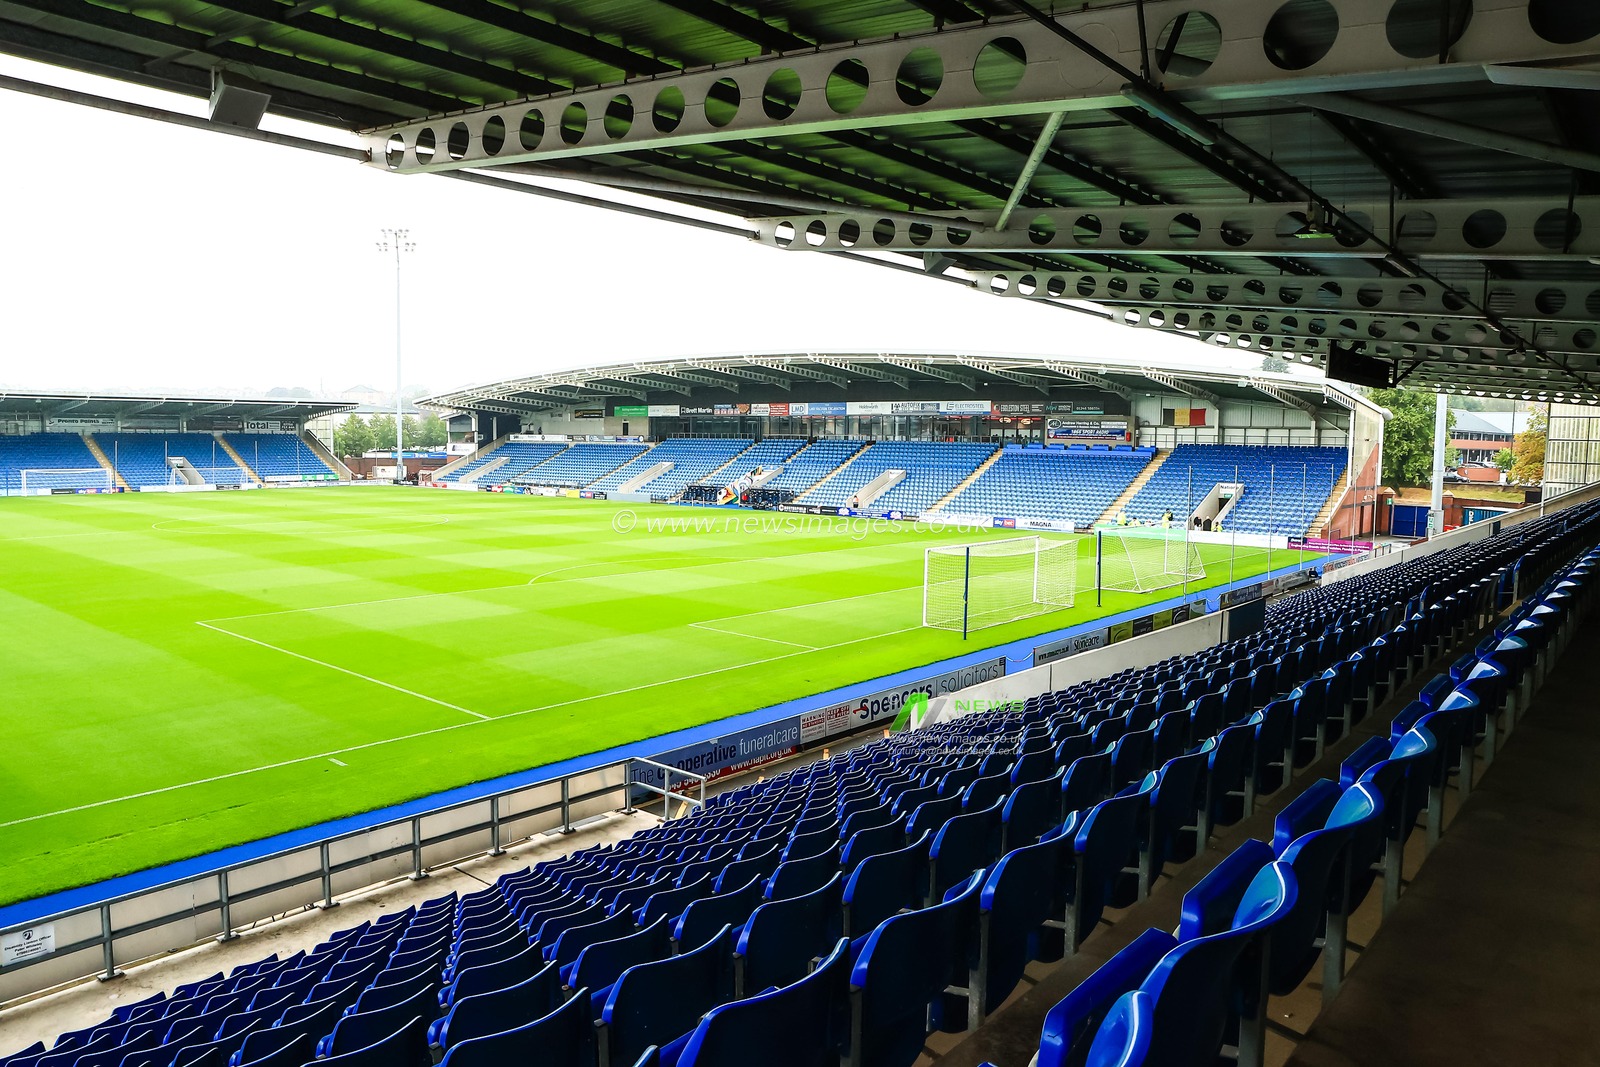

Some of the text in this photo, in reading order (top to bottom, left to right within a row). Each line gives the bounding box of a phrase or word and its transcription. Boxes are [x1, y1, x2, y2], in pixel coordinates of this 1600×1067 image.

[246, 422, 269, 430] Total
[940, 663, 999, 693] solicitors
[860, 683, 933, 720] Spencers
[802, 712, 824, 722] WARNING
[631, 767, 654, 784] The
[739, 726, 798, 756] funeralcare
